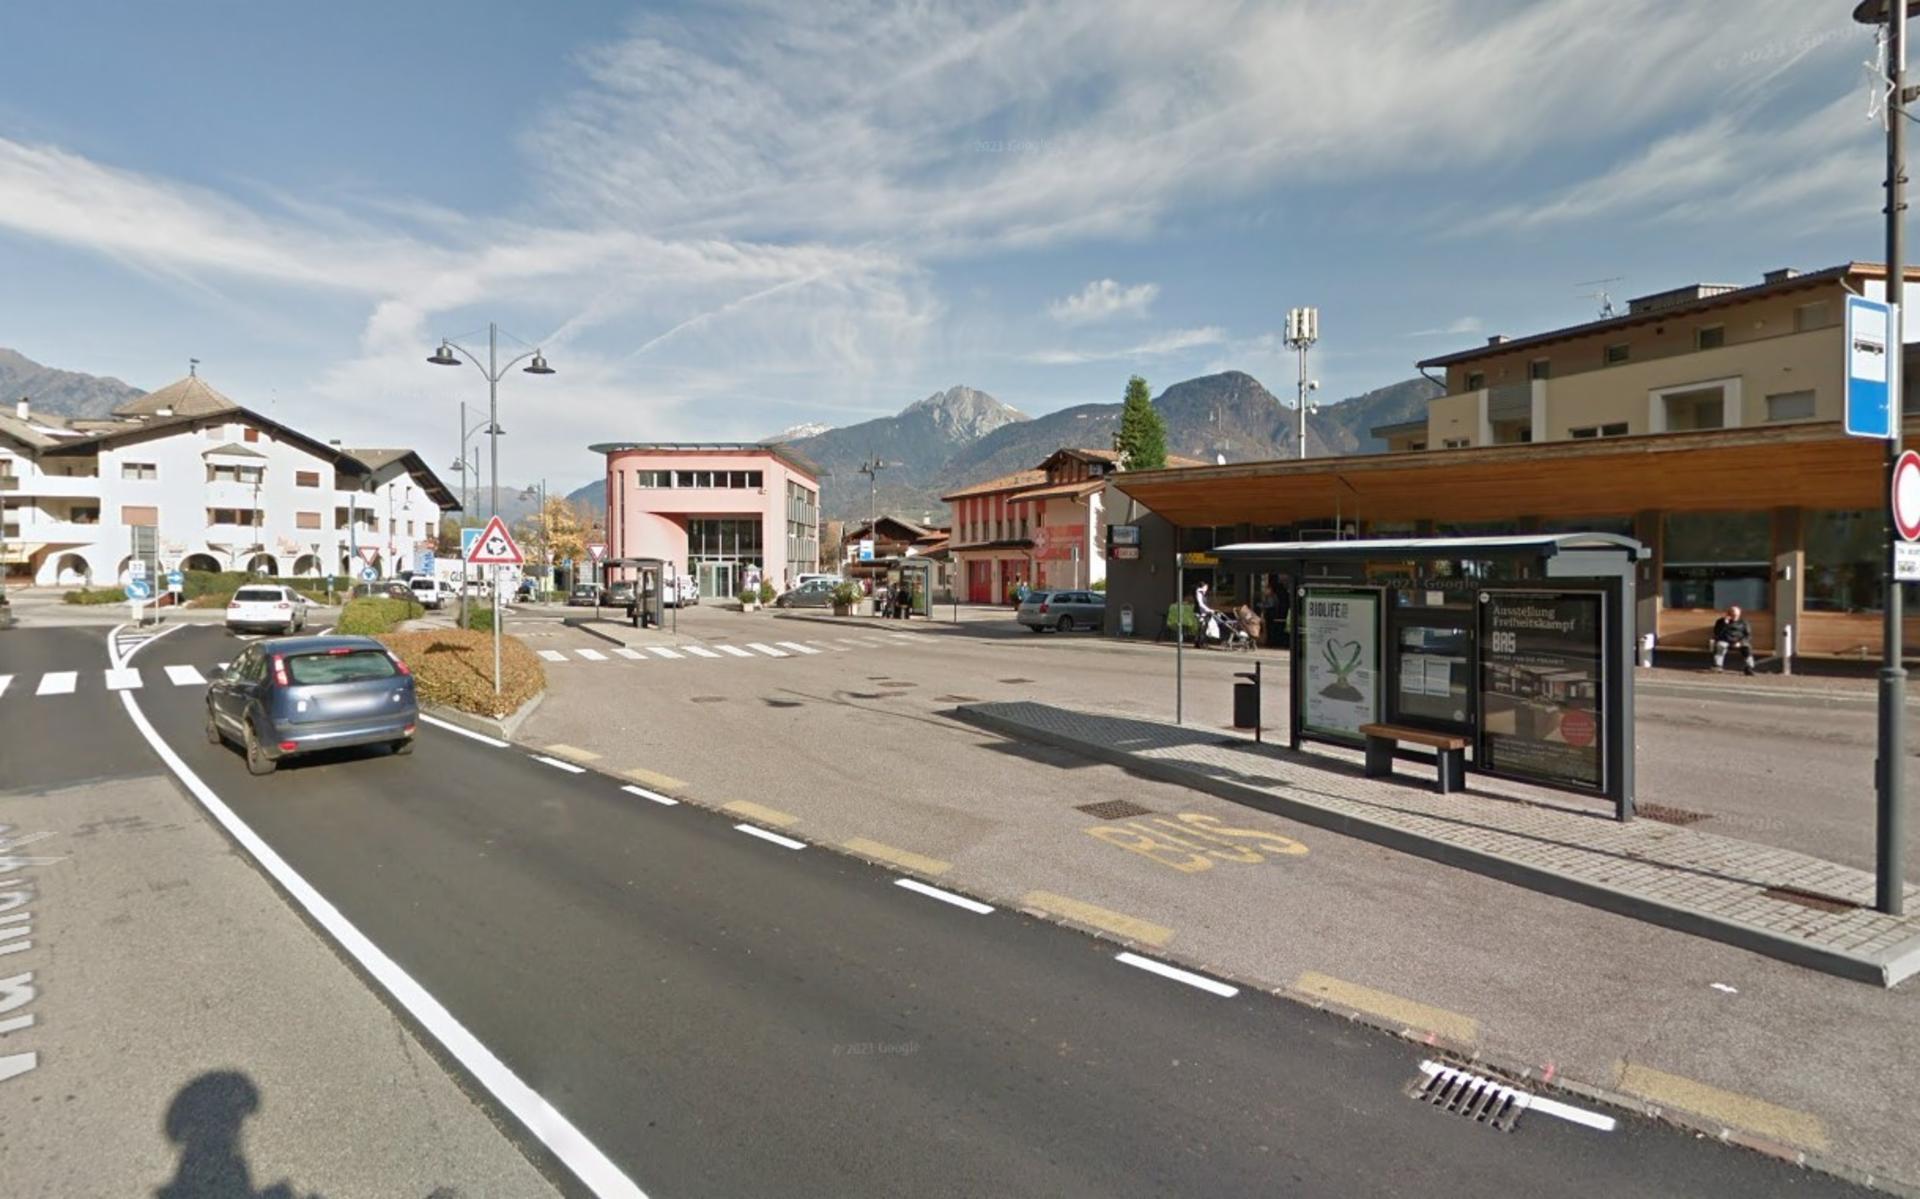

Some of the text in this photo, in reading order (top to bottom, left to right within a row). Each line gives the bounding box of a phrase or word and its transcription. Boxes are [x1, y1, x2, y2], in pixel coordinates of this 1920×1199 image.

[1308, 601, 1341, 619] BIOLIFE
[1493, 605, 1556, 620] Ausstellung
[1492, 616, 1576, 633] Freiheitskampf
[1492, 631, 1516, 653] BAS
[1084, 813, 1310, 874] BUS
